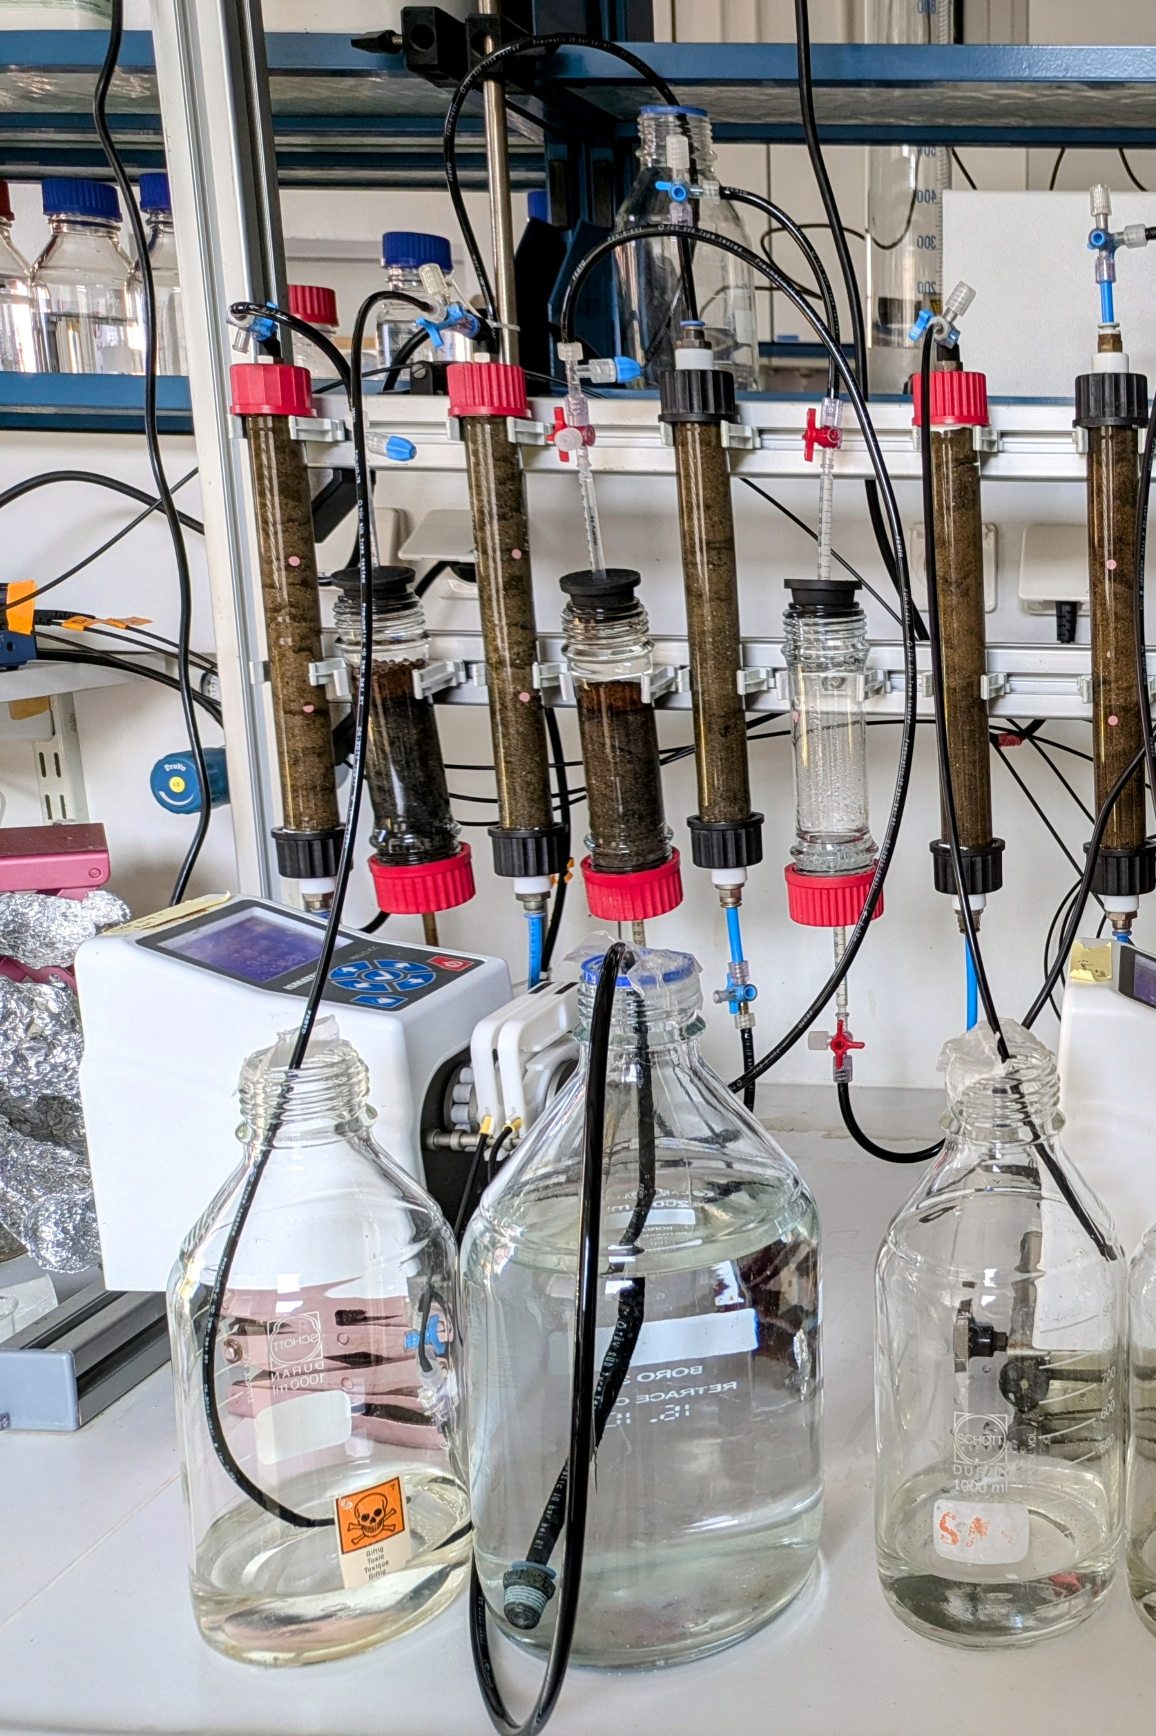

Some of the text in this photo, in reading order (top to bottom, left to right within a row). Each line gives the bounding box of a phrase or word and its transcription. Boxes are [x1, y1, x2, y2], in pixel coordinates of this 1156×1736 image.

[302, 1010, 312, 1035] FESTO
[1101, 1366, 1116, 1383] 700
[1100, 1401, 1115, 1417] 600
[956, 1433, 1003, 1447] SCHOTT
[955, 1479, 1008, 1493] 1000 ml
[366, 1546, 384, 1557] Giftig
[367, 1554, 385, 1565] Toxic
[363, 1560, 390, 1574] Toxique
